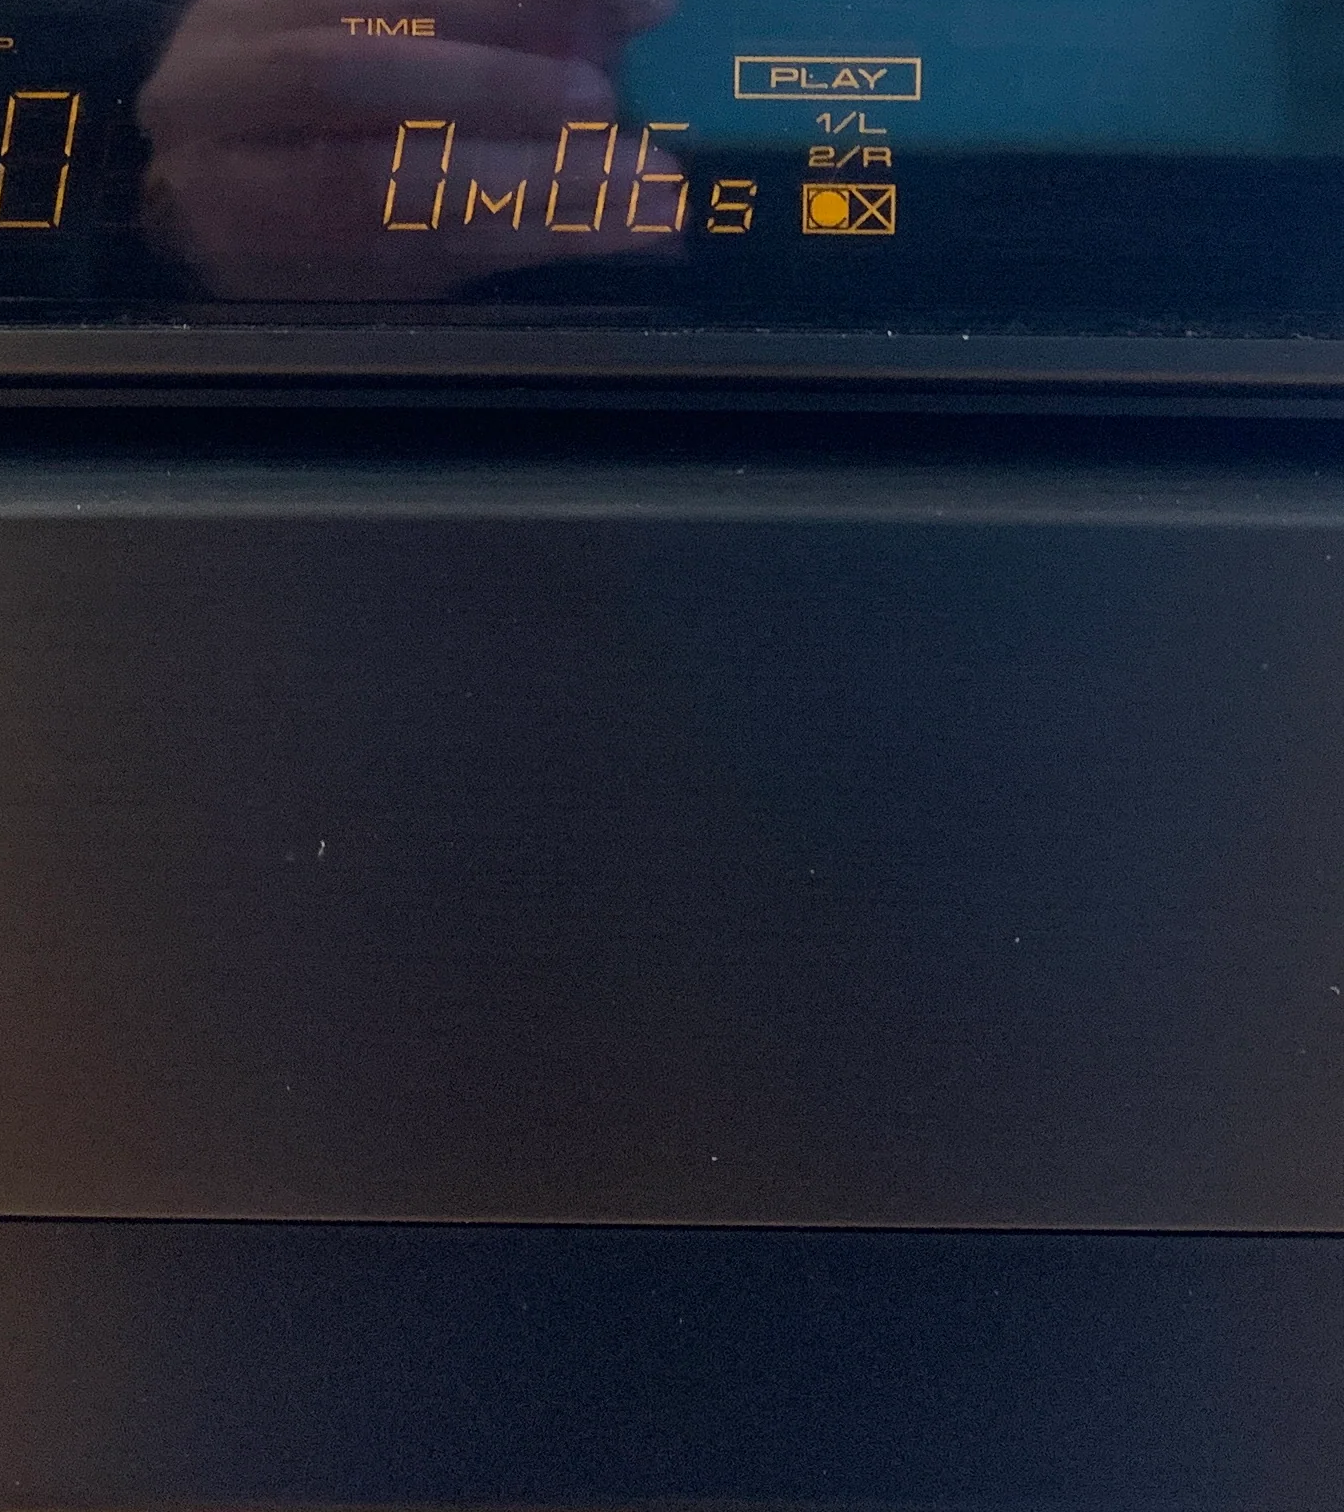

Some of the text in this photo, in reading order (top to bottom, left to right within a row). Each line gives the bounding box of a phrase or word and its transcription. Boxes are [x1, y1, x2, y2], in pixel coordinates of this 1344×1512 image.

[341, 18, 436, 36] TIME
[769, 67, 888, 90] PLAY
[816, 112, 887, 134] 1/L
[808, 146, 892, 168] 2/R
